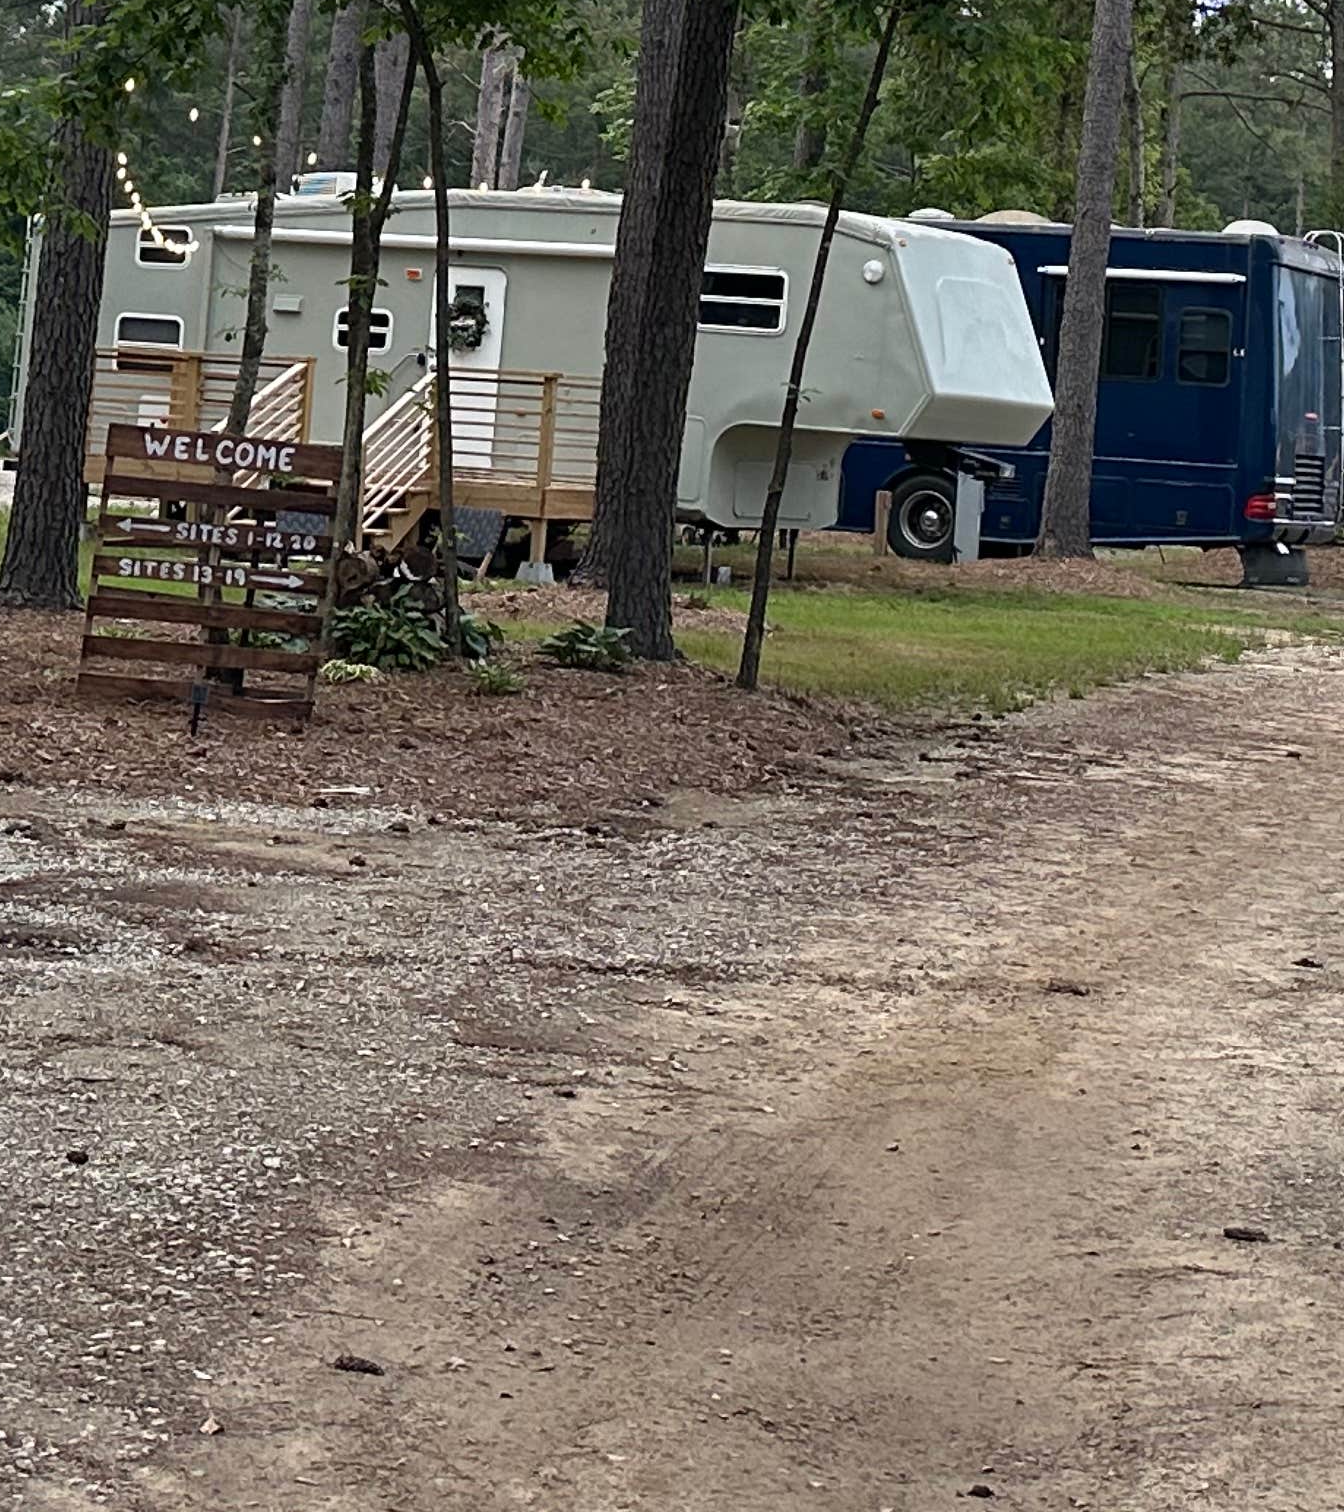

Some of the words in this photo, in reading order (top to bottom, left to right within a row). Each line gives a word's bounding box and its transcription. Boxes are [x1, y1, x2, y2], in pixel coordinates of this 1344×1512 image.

[143, 432, 296, 473] WELCOME
[175, 522, 239, 545] SITES
[118, 557, 186, 581] SITES
